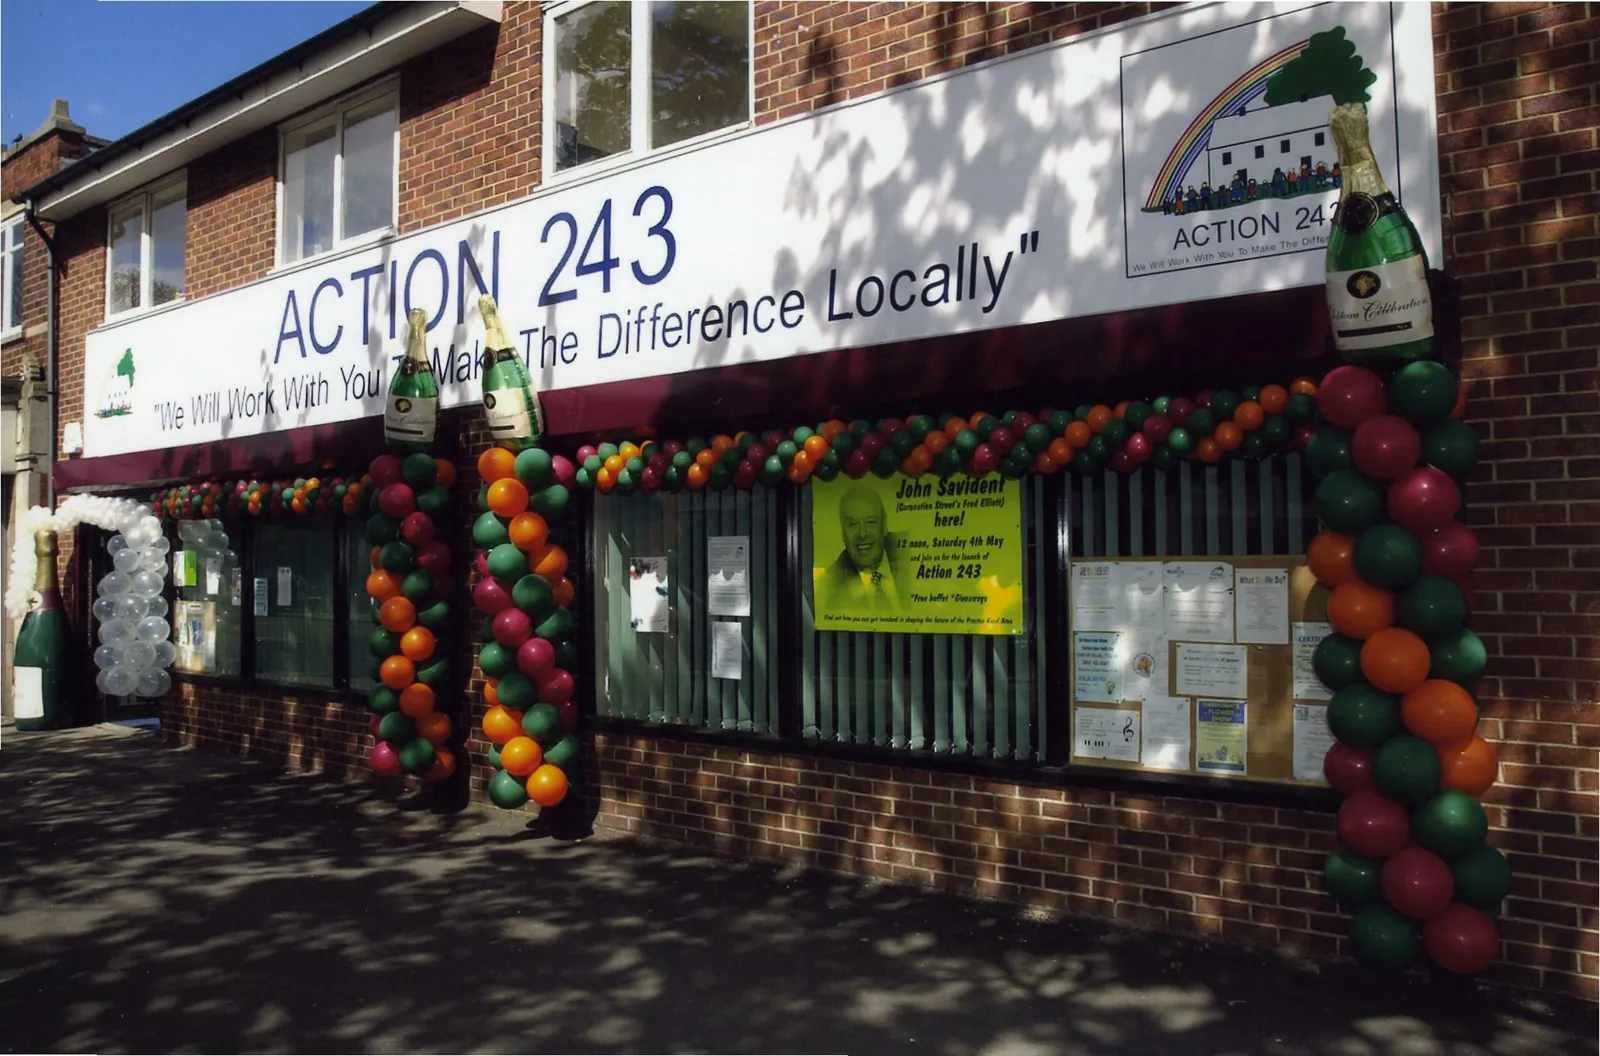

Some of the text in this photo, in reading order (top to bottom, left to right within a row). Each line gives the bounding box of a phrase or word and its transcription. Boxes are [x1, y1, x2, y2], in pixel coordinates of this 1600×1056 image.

[1173, 211, 1280, 250] ACTION
[1132, 264, 1146, 272] We
[1149, 260, 1165, 270] Will
[1167, 256, 1190, 267] Work
[1194, 253, 1214, 264] With
[1217, 249, 1234, 259] You
[1238, 248, 1248, 256] To
[1251, 243, 1276, 254] Make
[1280, 240, 1298, 249] The
[273, 185, 677, 364] ACTION 243
[154, 230, 1039, 431] "We Will Work With You Mak The Difference Locally"
[896, 476, 1006, 499] John Savident
[896, 496, 1005, 513] (Coronation Street's Fred Elliott)
[934, 510, 965, 527] here!
[898, 535, 1004, 549] 12 noon, Saturday 4th May
[910, 554, 920, 562] and
[921, 554, 932, 563] join
[942, 552, 950, 561] for
[951, 552, 960, 560] the
[962, 552, 980, 560] launch
[982, 552, 990, 560] of
[916, 563, 982, 579] Action 243
[929, 592, 948, 602] buffet
